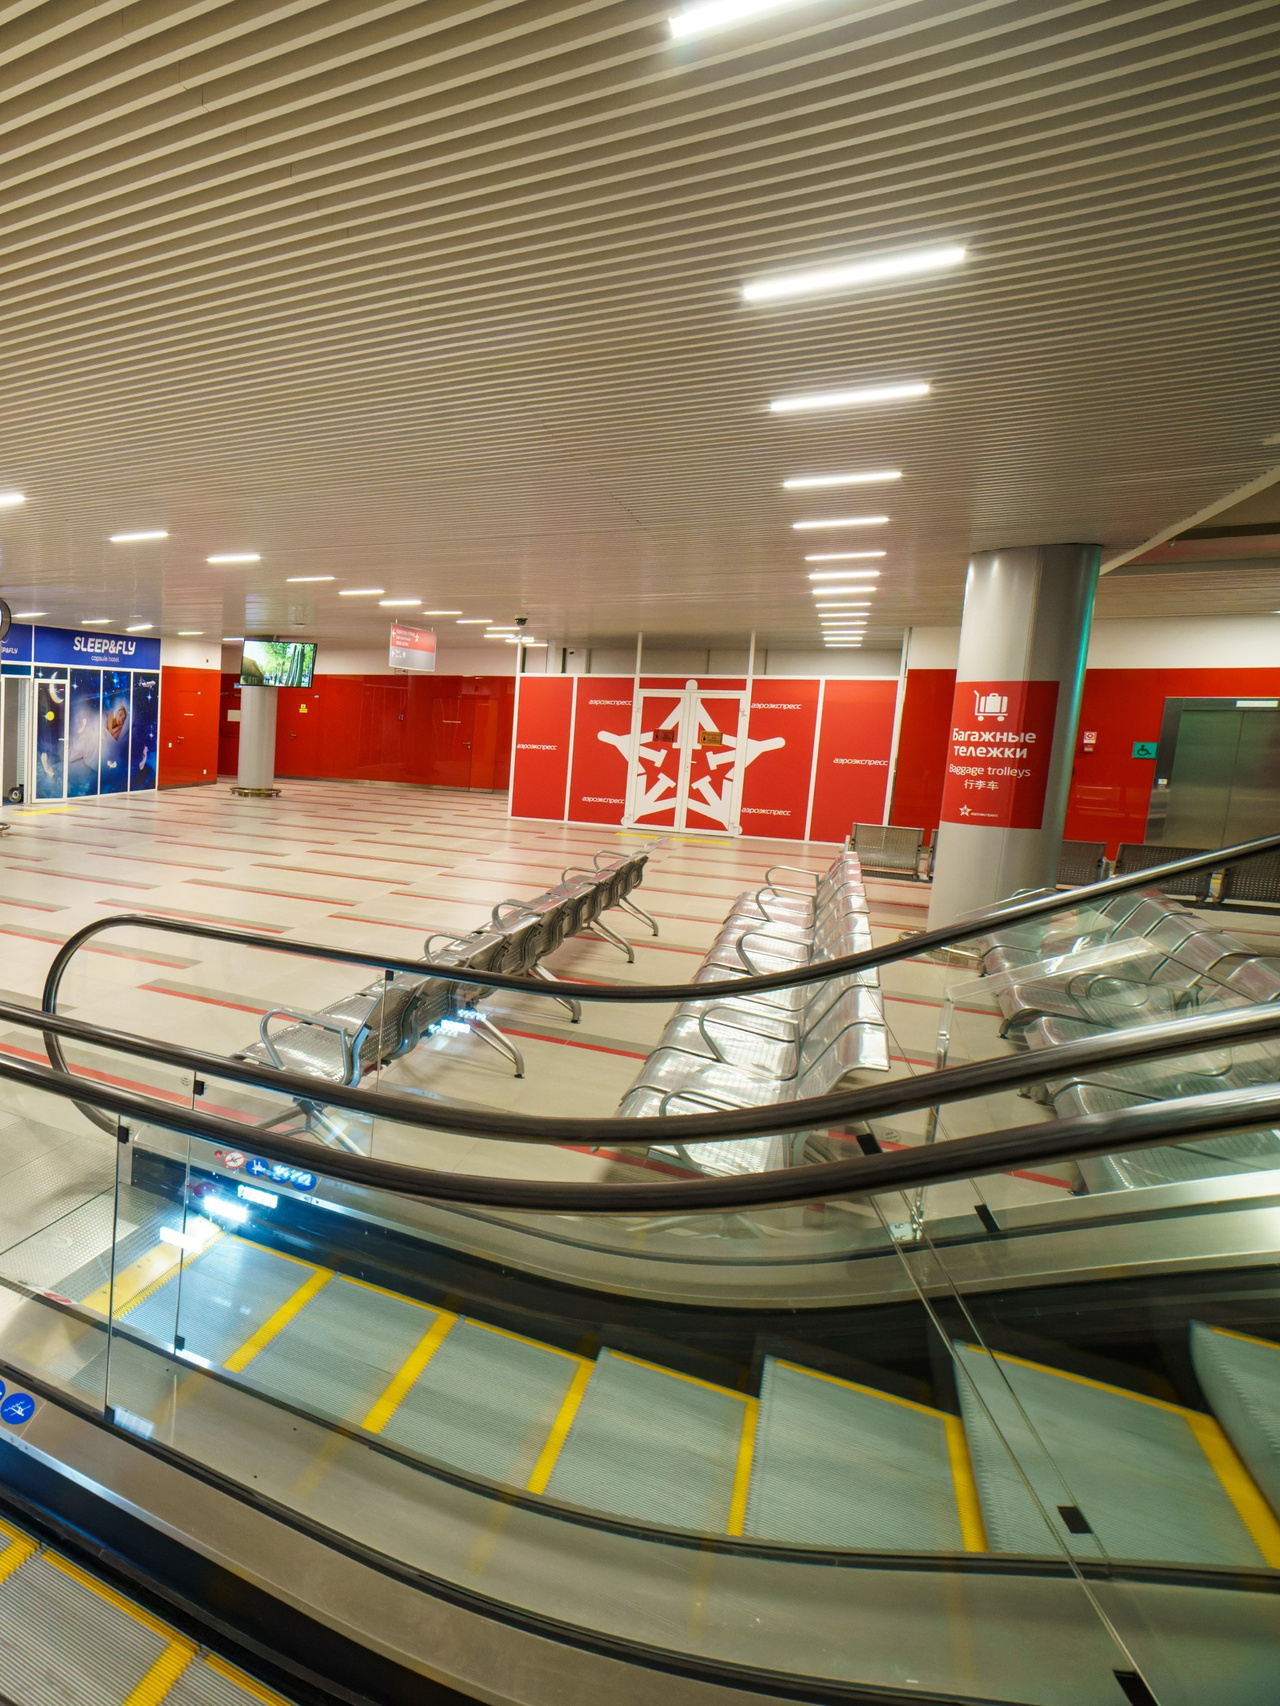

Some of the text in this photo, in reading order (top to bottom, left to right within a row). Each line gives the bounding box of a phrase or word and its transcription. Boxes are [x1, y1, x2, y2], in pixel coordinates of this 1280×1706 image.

[73, 636, 136, 656] SLEEP&FLY
[750, 702, 802, 710] аэроэкспресс
[952, 728, 1036, 743] Багажные
[516, 743, 558, 751] аэроэкспресс
[953, 745, 1028, 759] тележки
[833, 758, 888, 766] аэроэкспресс
[949, 764, 1031, 778] Baggage trolleys
[964, 779, 999, 790] 行李车
[582, 796, 626, 804] аэроэкспресс
[741, 807, 792, 816] аэроэкспресс
